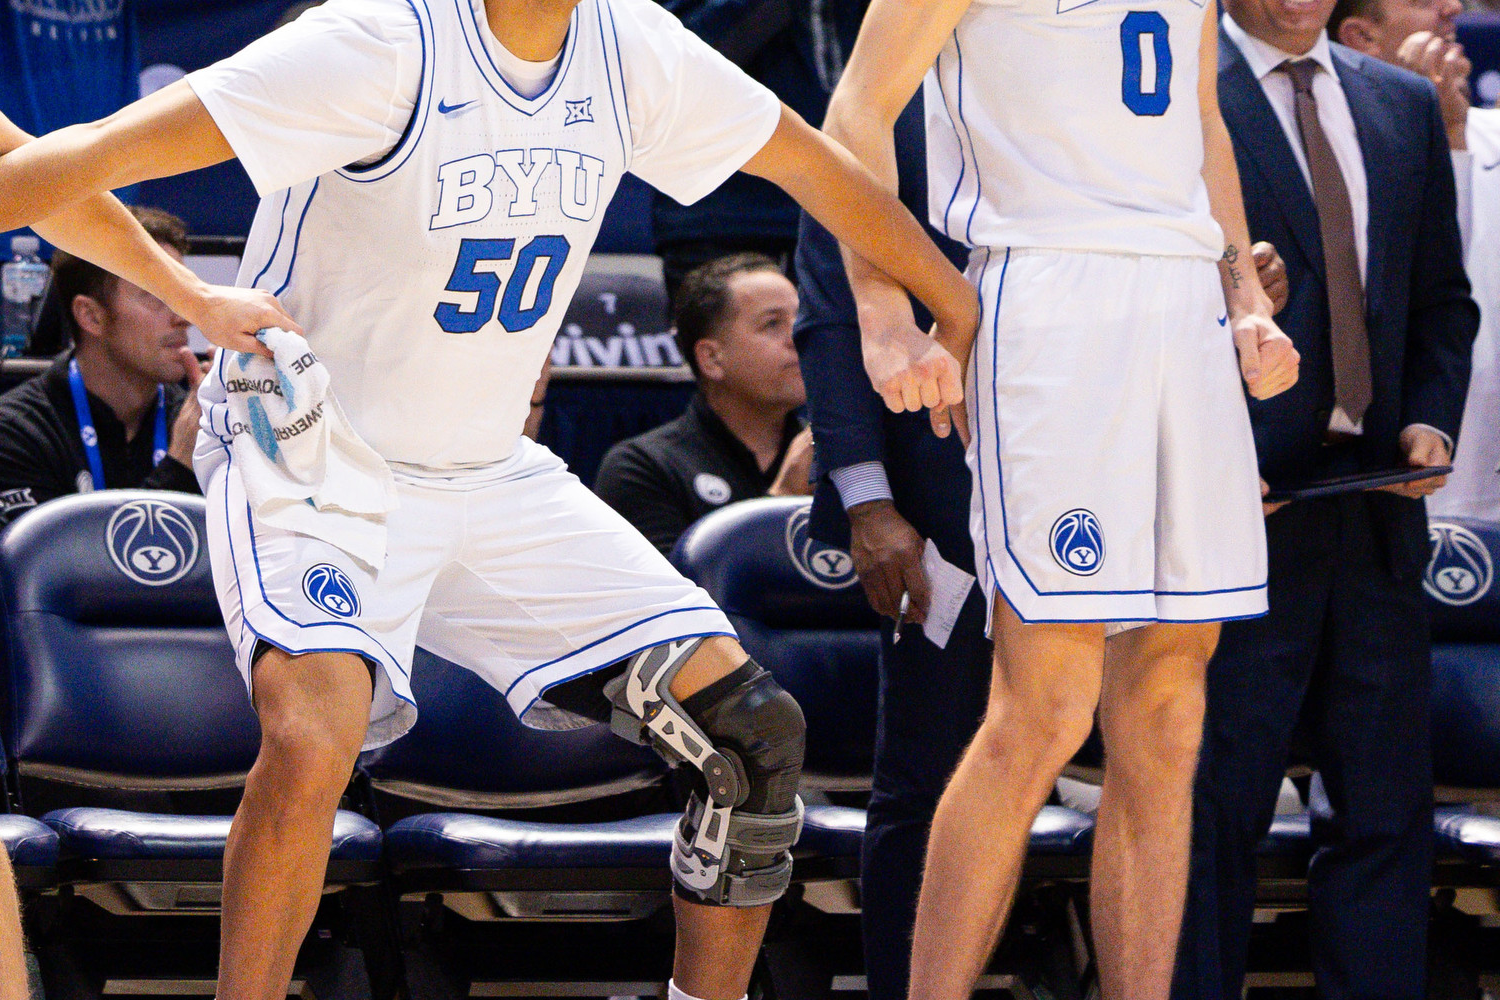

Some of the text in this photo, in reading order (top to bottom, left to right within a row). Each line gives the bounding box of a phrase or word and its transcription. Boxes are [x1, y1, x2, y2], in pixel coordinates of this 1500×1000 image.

[1120, 10, 1173, 116] 0
[429, 147, 605, 231] BYU
[433, 234, 571, 334] 50
[140, 551, 168, 570] Y
[819, 553, 845, 574] Y
[1074, 549, 1092, 564] Y
[1443, 571, 1466, 590] Y
[329, 596, 346, 611] Y
